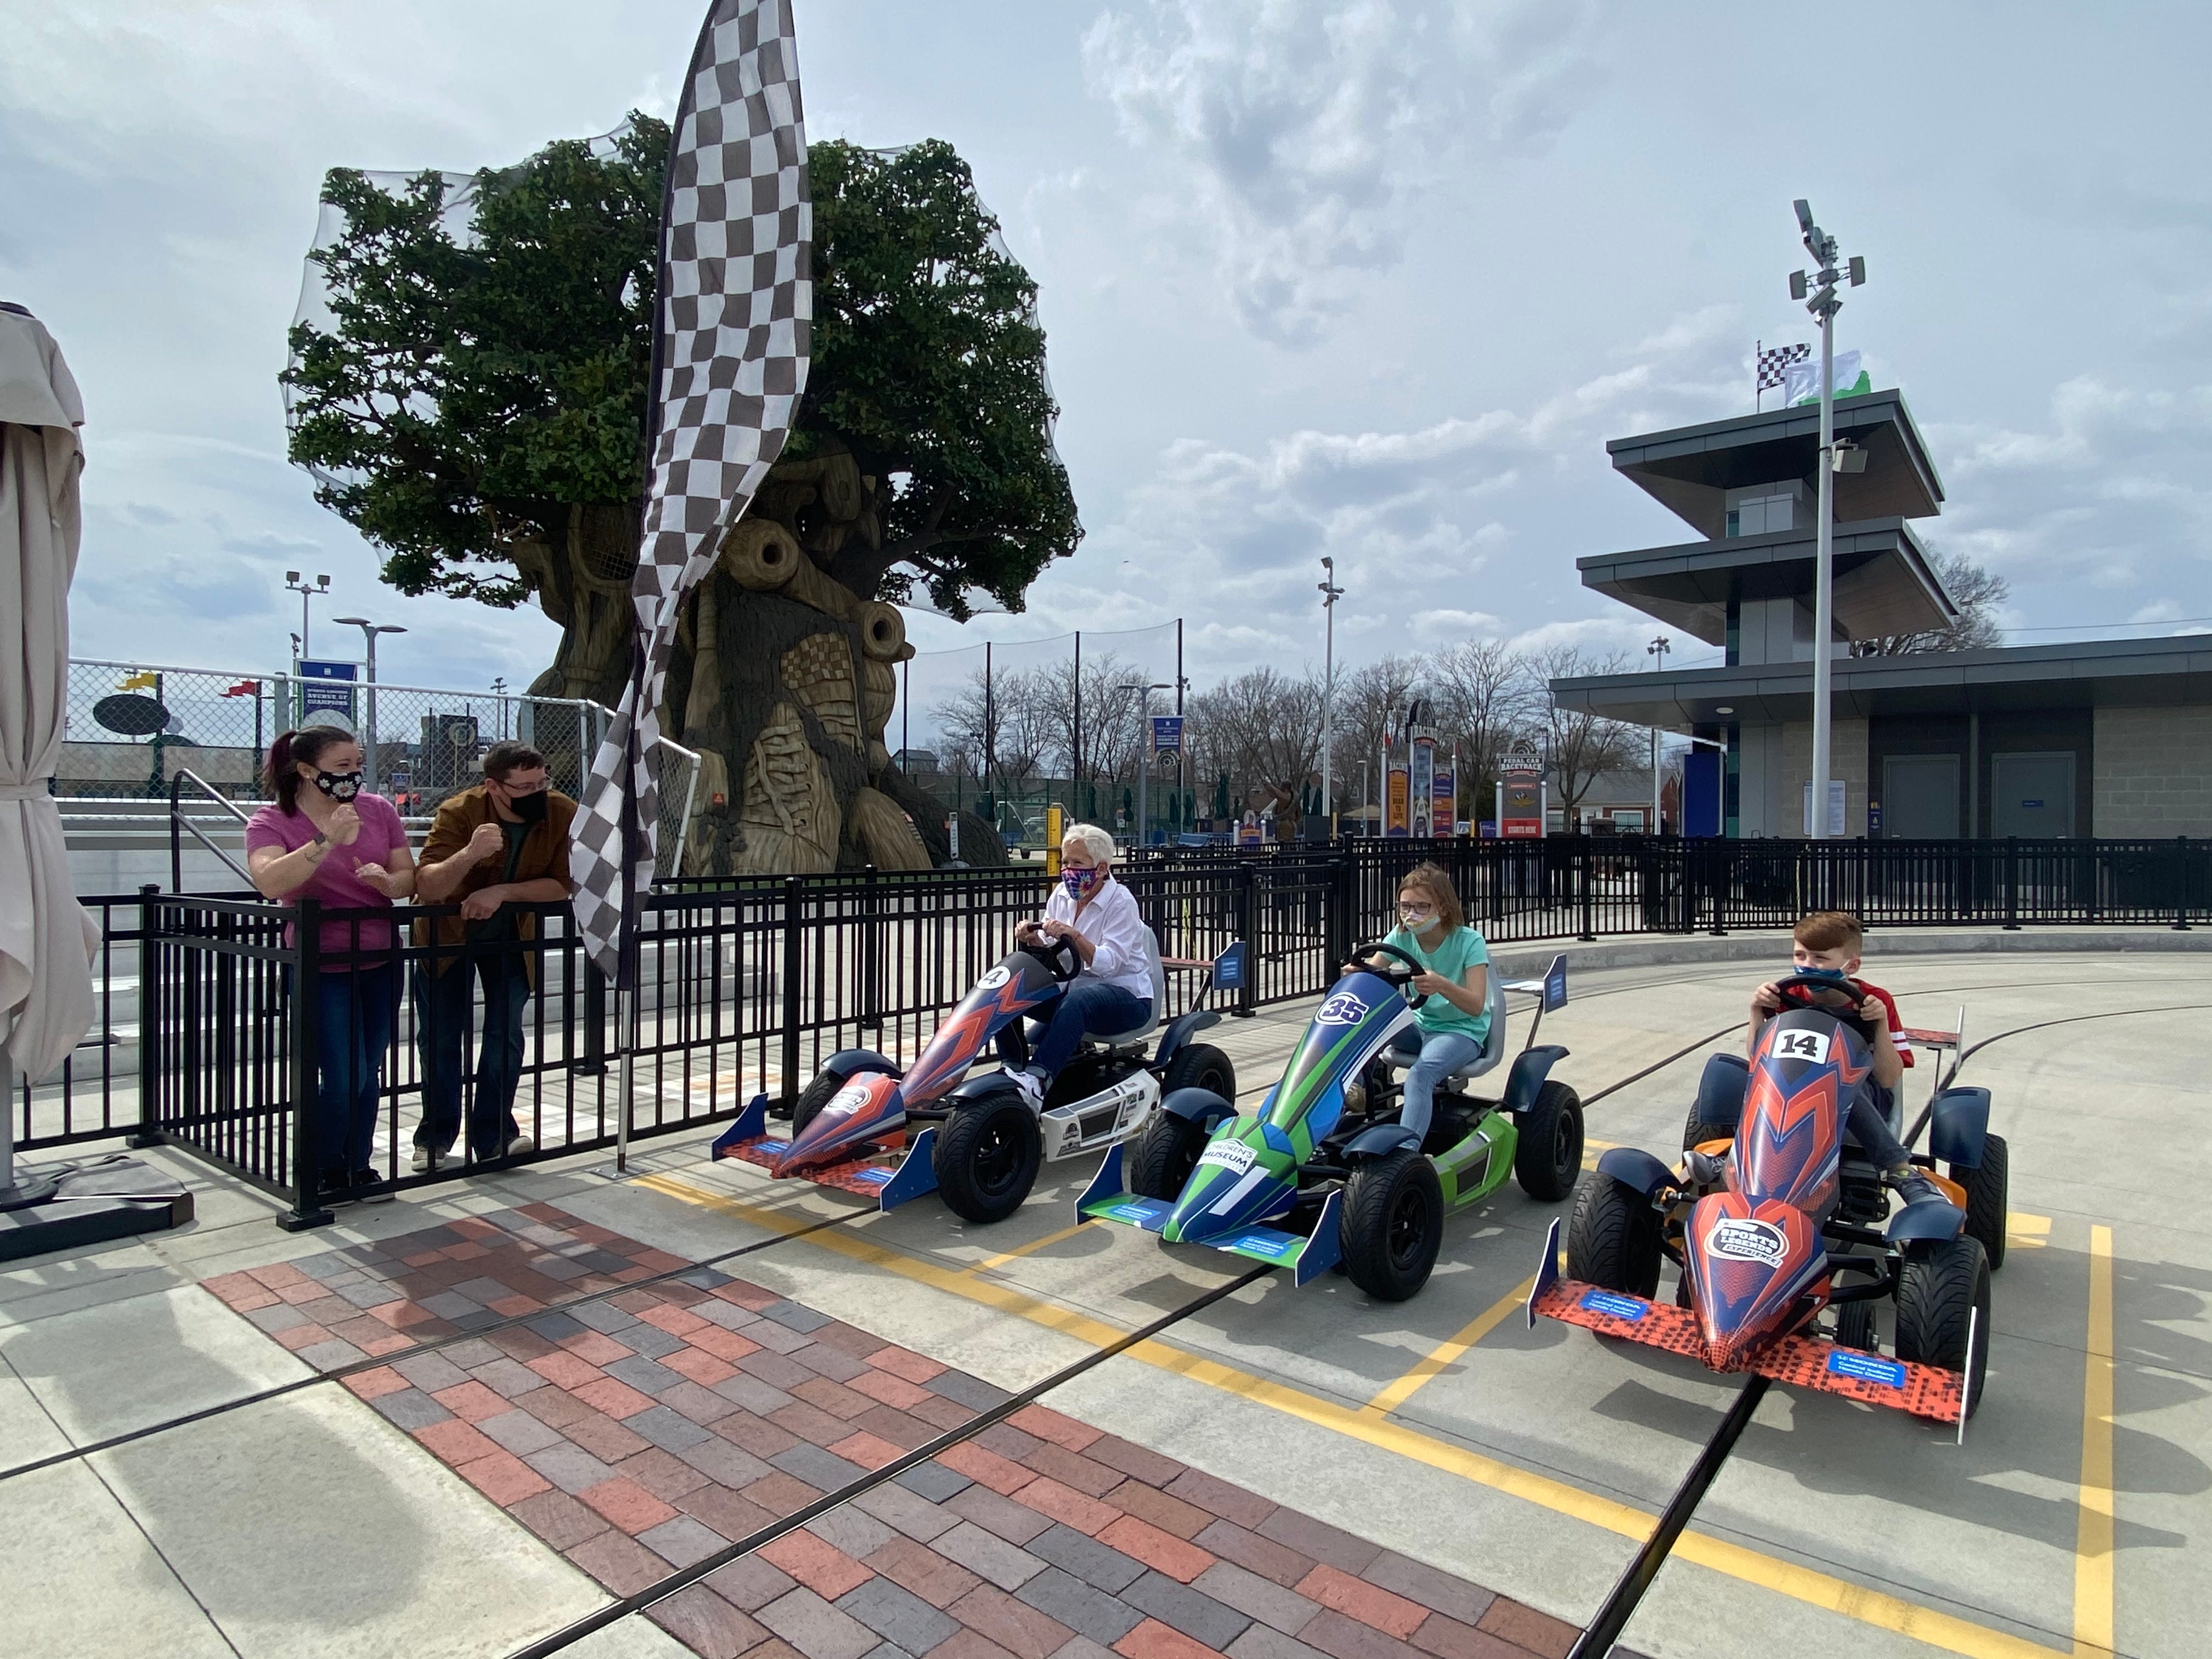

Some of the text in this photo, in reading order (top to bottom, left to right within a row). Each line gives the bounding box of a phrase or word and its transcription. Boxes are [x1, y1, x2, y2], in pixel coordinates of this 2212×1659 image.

[1413, 725, 1438, 742] RACING
[1500, 763, 1542, 771] RACETRACK
[983, 970, 1004, 985] 4
[1322, 998, 1368, 1023] 35
[1780, 1034, 1818, 1058] 14
[1204, 1151, 1248, 1168] MUSEUM
[1208, 1143, 1254, 1159] CHILDREN'S
[1720, 1228, 1779, 1249] SPORTS
[1720, 1236, 1773, 1255] LEGENDS
[1725, 1245, 1778, 1263] EXPERIENCE
[1602, 1296, 1641, 1310] HONDA
[1838, 1361, 1895, 1378] Central Indiana
[1849, 1357, 1898, 1373] HONDA
[1838, 1365, 1894, 1383] Honda Dealers
